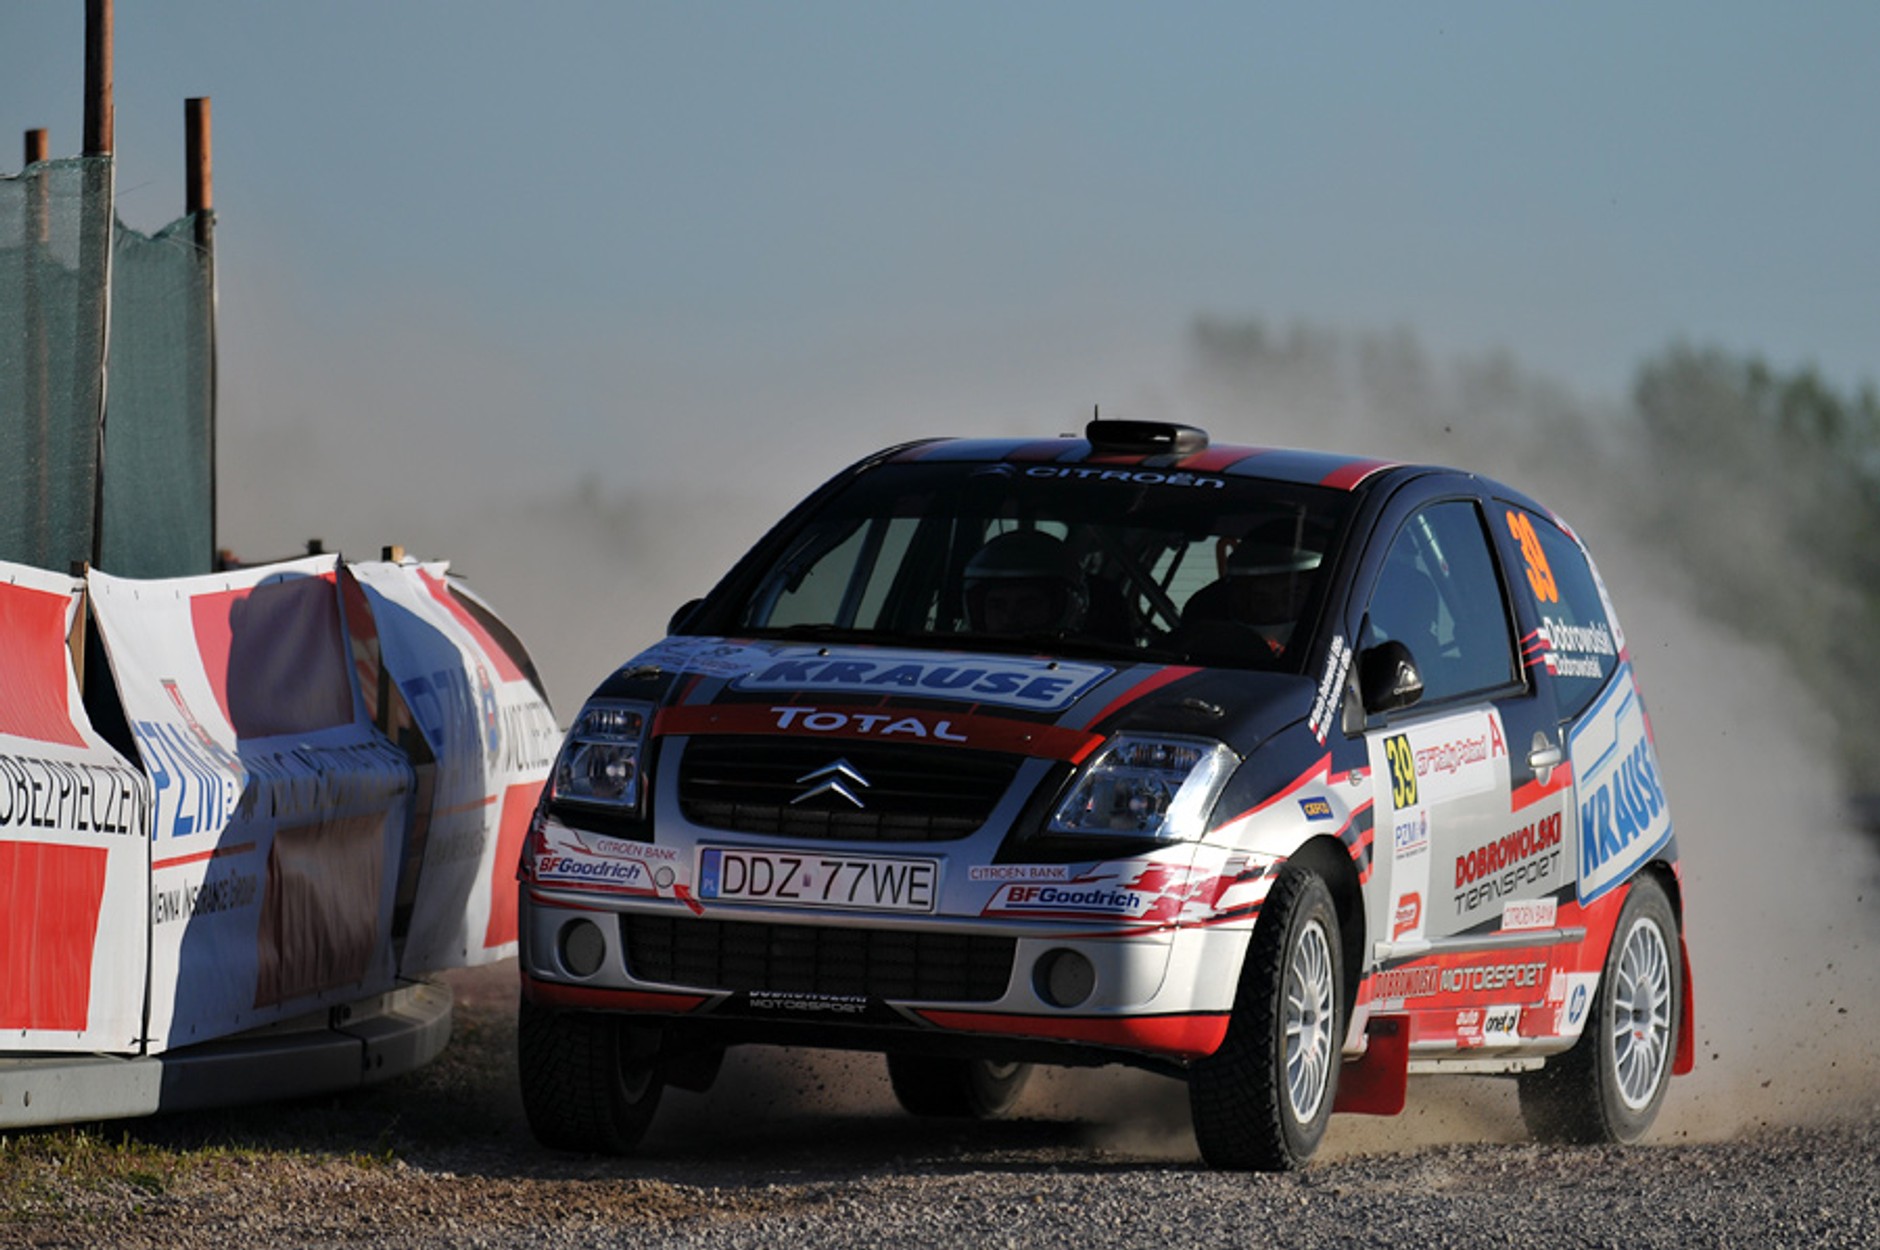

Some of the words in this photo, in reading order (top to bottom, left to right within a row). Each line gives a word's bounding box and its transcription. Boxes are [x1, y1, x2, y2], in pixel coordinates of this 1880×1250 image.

[1506, 509, 1559, 604] 39
[756, 660, 1074, 701] KRAUSE
[770, 706, 969, 742] TOTAL
[1488, 712, 1506, 758] A
[131, 720, 223, 841] PZM
[1387, 736, 1416, 809] 39
[539, 857, 641, 879] BFGoodrich
[644, 848, 678, 861] BANK
[1454, 811, 1562, 890] DOBROWOLSKI
[721, 855, 801, 899] DDZ
[820, 860, 931, 906] 77WE
[1030, 867, 1067, 879] BANK
[1454, 850, 1560, 916] TRANSPORT
[1006, 886, 1140, 909] BFGoodrich
[1439, 962, 1547, 993] MOTORSPORT
